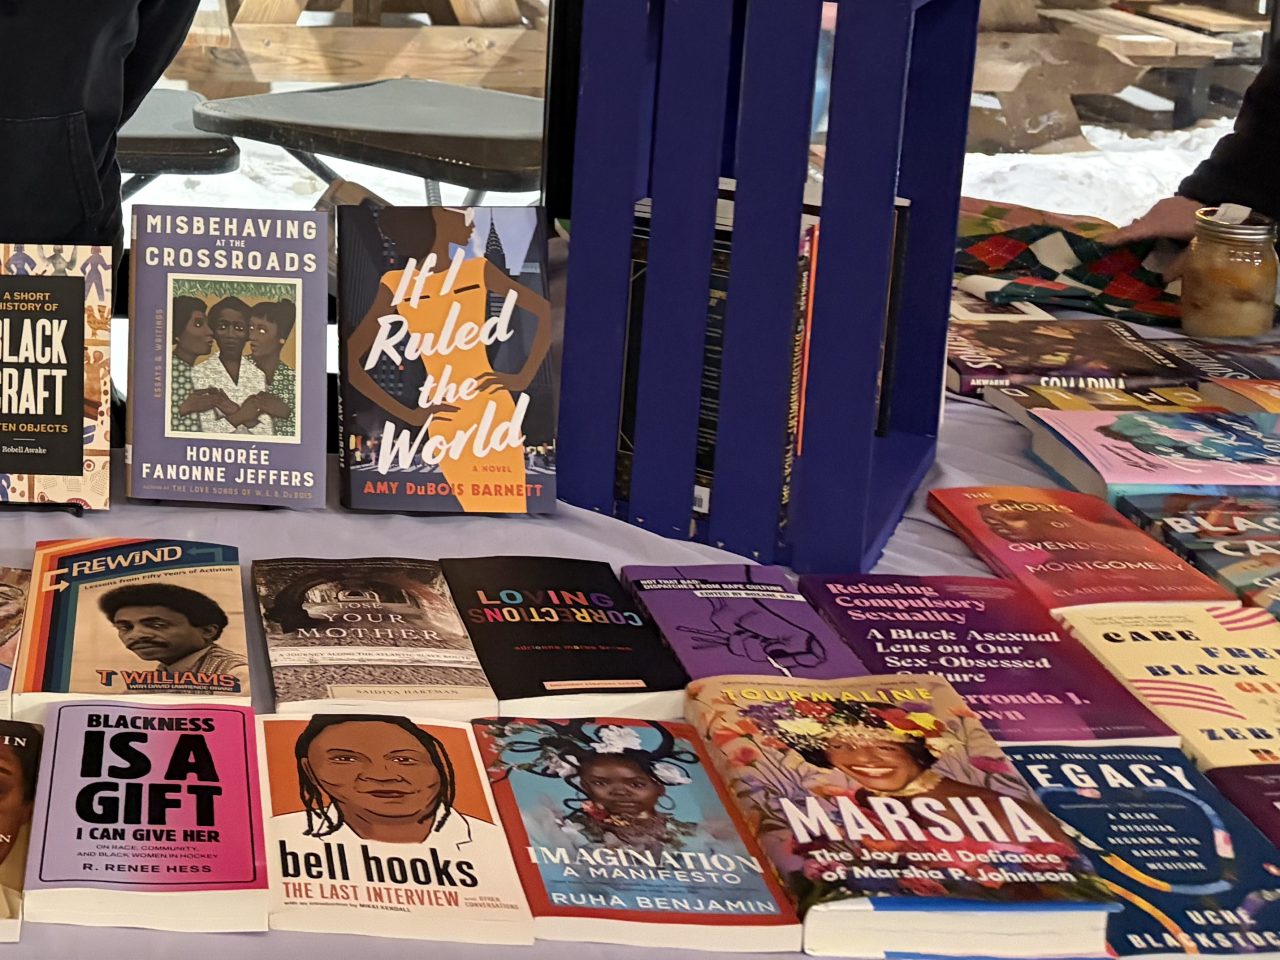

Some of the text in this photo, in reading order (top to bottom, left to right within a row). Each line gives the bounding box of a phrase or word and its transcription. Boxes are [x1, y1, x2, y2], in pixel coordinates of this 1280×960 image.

[147, 215, 317, 240] MISBEHAVING
[229, 240, 245, 248] THE
[145, 247, 317, 272] CROSSROADS
[390, 247, 464, 308] If I
[3, 292, 50, 301] A SHORT
[44, 303, 59, 311] OF
[365, 289, 518, 371] Ruled
[418, 364, 478, 409] the
[19, 423, 68, 433] OBJECTS
[378, 393, 530, 475] World
[24, 445, 47, 455] Awake
[186, 445, 270, 465] HONORÉE
[142, 463, 314, 487] FANONNE JEFFERS
[481, 465, 512, 473] NOVEL
[363, 481, 543, 497] AMY BARNETT
[990, 503, 1074, 515] GHOSTS
[1025, 562, 1186, 574] MONTGOMERY
[84, 580, 118, 590] Lessons
[119, 576, 140, 584] from
[826, 583, 939, 597] Refusing
[476, 589, 614, 607] LOVING
[835, 596, 986, 612] Compulsory
[321, 613, 407, 624] YOUR
[468, 607, 644, 626] CORRECTIONS
[847, 610, 966, 624] Sexuality
[297, 628, 440, 641] MOTHER
[867, 628, 1061, 642] A Black Asexual
[1102, 630, 1201, 643] CARE
[875, 642, 1024, 655] Lens on Our
[884, 656, 1052, 669] Sex-Obsessed
[1145, 664, 1268, 676] BLACK
[96, 669, 118, 687] T
[722, 688, 933, 702] TOURMALINE
[86, 714, 215, 733] BLACKNESS
[79, 731, 220, 782] IS A
[1026, 763, 1197, 791] EGACY
[75, 780, 223, 827] GIFT
[777, 796, 1056, 844] MARSHA
[76, 827, 221, 843] I CAN GIVE HER
[279, 840, 479, 888] bell hooks
[526, 846, 764, 874] IMAGINATION
[808, 849, 1062, 865] The Joy and Defiance
[82, 863, 212, 873] R. RENEE HESS
[562, 866, 741, 885] A MANIFESTO
[822, 866, 1077, 883] of Marsha P. Johnson
[283, 882, 459, 907] THE LAST INTERVIEW
[552, 893, 776, 913] RUHA BENJAMIN
